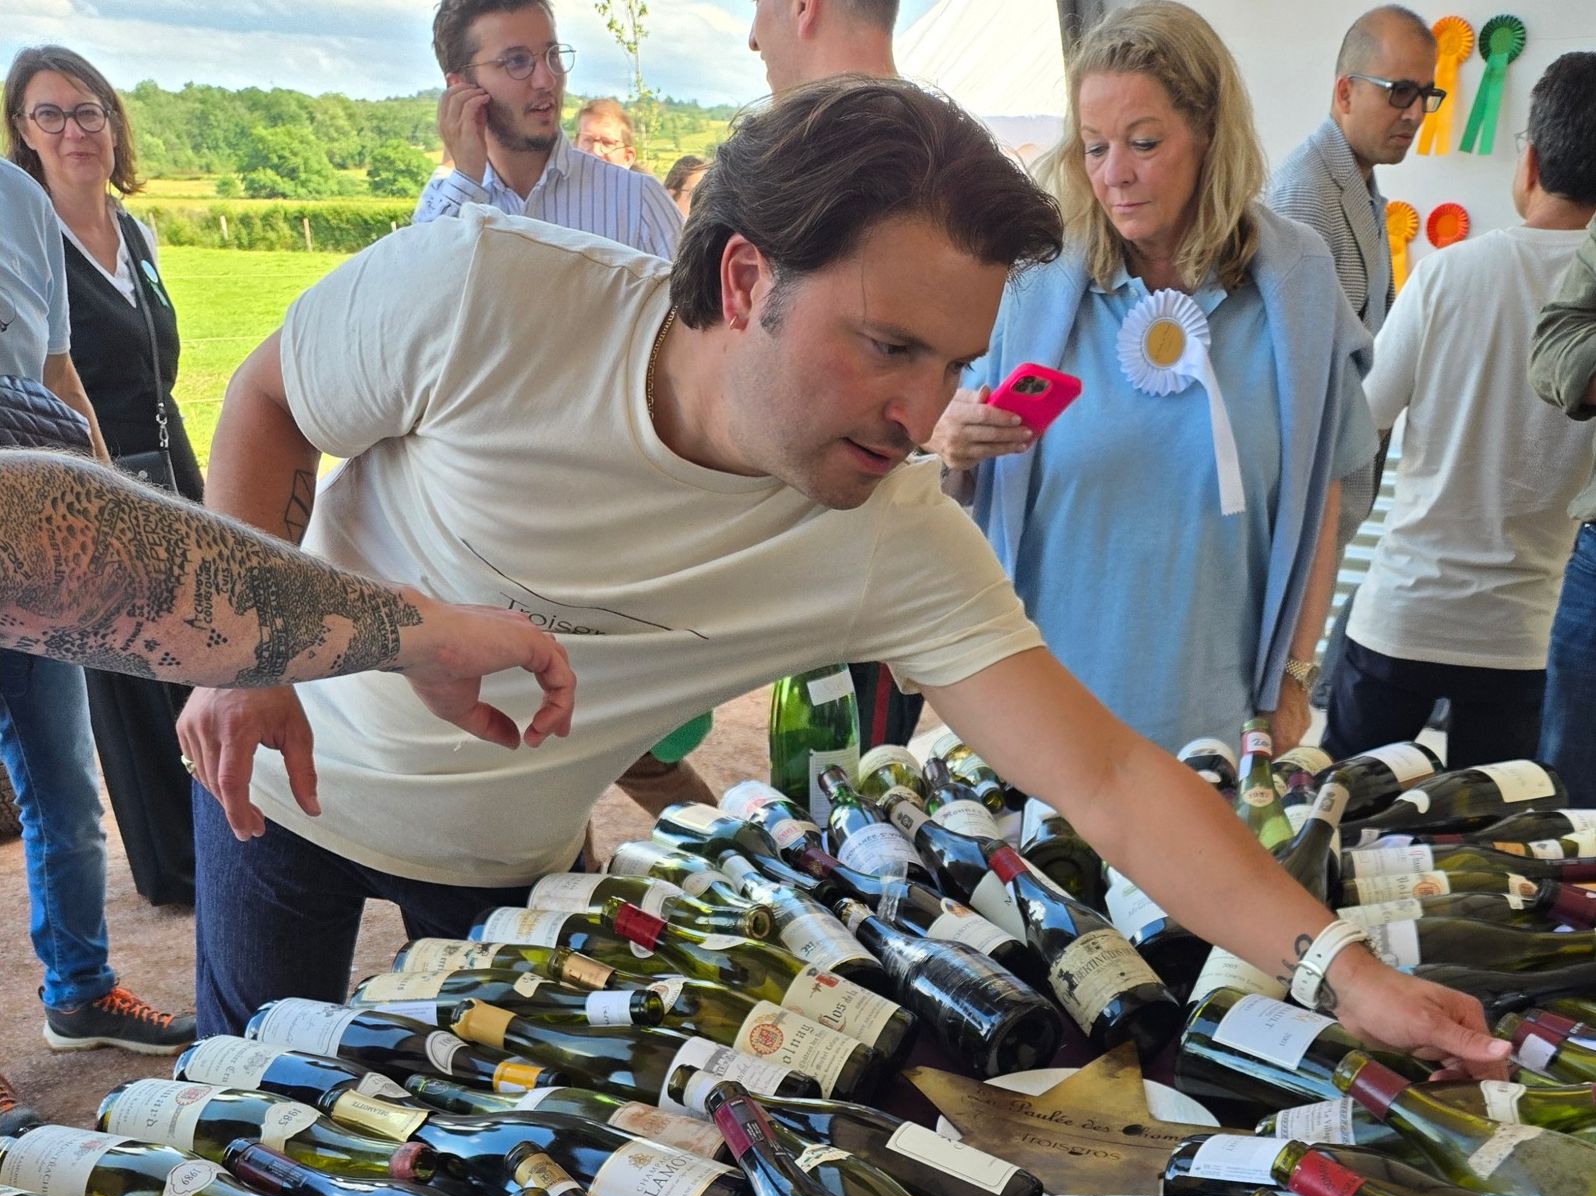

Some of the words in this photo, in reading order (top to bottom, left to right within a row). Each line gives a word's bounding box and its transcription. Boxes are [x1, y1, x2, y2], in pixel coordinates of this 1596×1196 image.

[782, 1023, 815, 1065] olnay
[277, 1107, 303, 1128] 1985
[1009, 1100, 1074, 1126] Paulée
[1021, 1133, 1122, 1161] Troisgros
[181, 1167, 203, 1186] 1989
